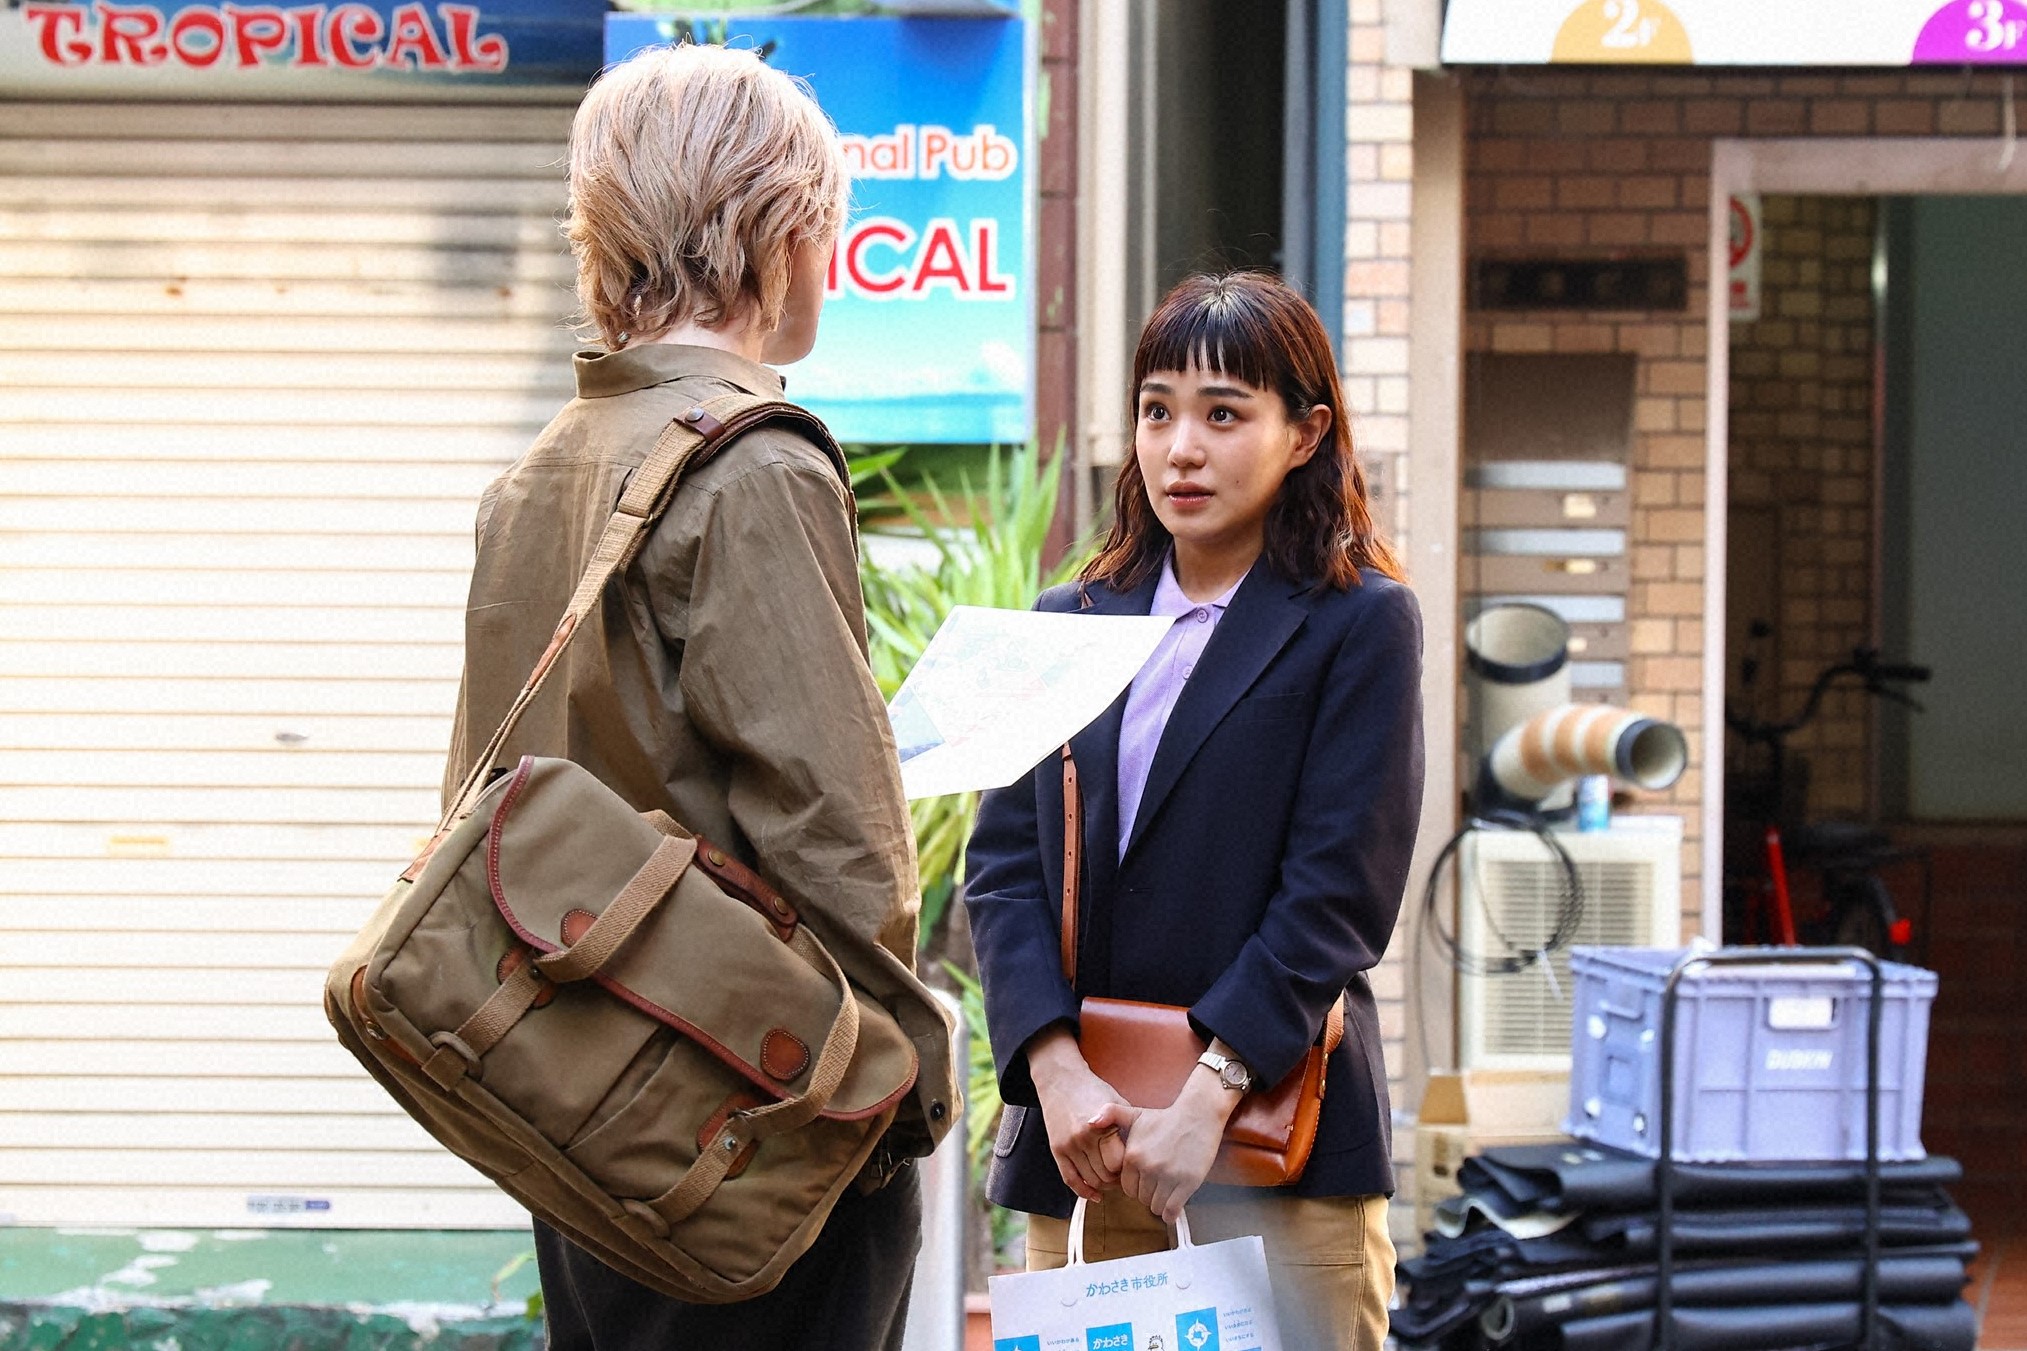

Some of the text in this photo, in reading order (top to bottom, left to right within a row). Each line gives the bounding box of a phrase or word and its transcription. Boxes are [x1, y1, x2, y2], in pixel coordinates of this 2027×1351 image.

[25, 2, 507, 73] TROPICAL
[923, 130, 1013, 175] Pub
[1085, 1271, 1169, 1298] かわさき市役所
[1092, 1333, 1129, 1350] かわさき
